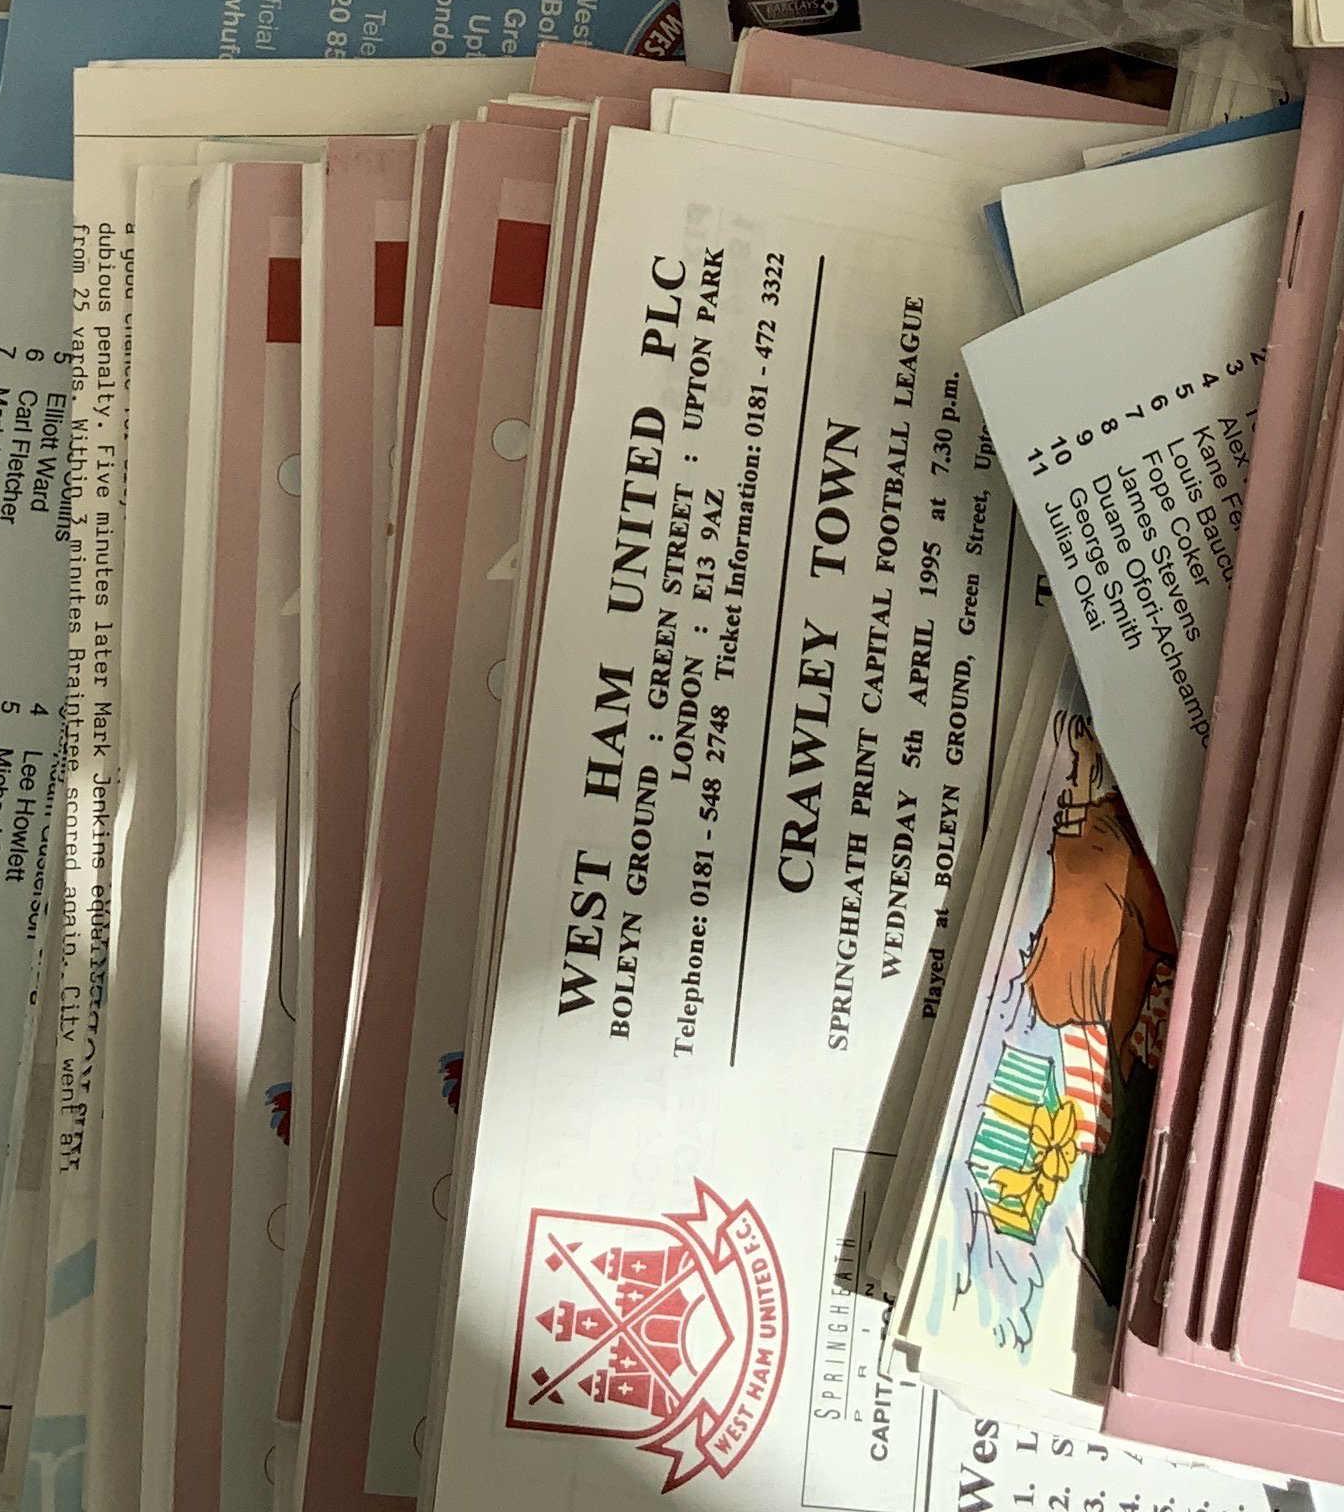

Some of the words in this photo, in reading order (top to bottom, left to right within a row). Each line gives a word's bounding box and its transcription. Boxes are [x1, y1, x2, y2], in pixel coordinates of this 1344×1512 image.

[641, 256, 686, 361] PLC
[894, 297, 924, 407] LEAGUE
[607, 407, 665, 613] UNITED
[876, 422, 910, 573] FOOTBALL
[1045, 502, 1078, 570] Julian
[1074, 575, 1105, 632] Okai
[1070, 488, 1110, 576] George
[1104, 580, 1143, 650] Smith
[1118, 466, 1157, 543] James
[1152, 545, 1201, 643] Stevens
[1142, 450, 1176, 512] Fope
[1171, 517, 1211, 586] Coker
[776, 614, 842, 893] CRAWLEY
[809, 418, 862, 579] TOWN
[862, 588, 892, 714] CAPITAL
[584, 663, 634, 802] HAM
[558, 850, 611, 1016] WEST
[828, 832, 868, 1051] SPRINGHEATH
